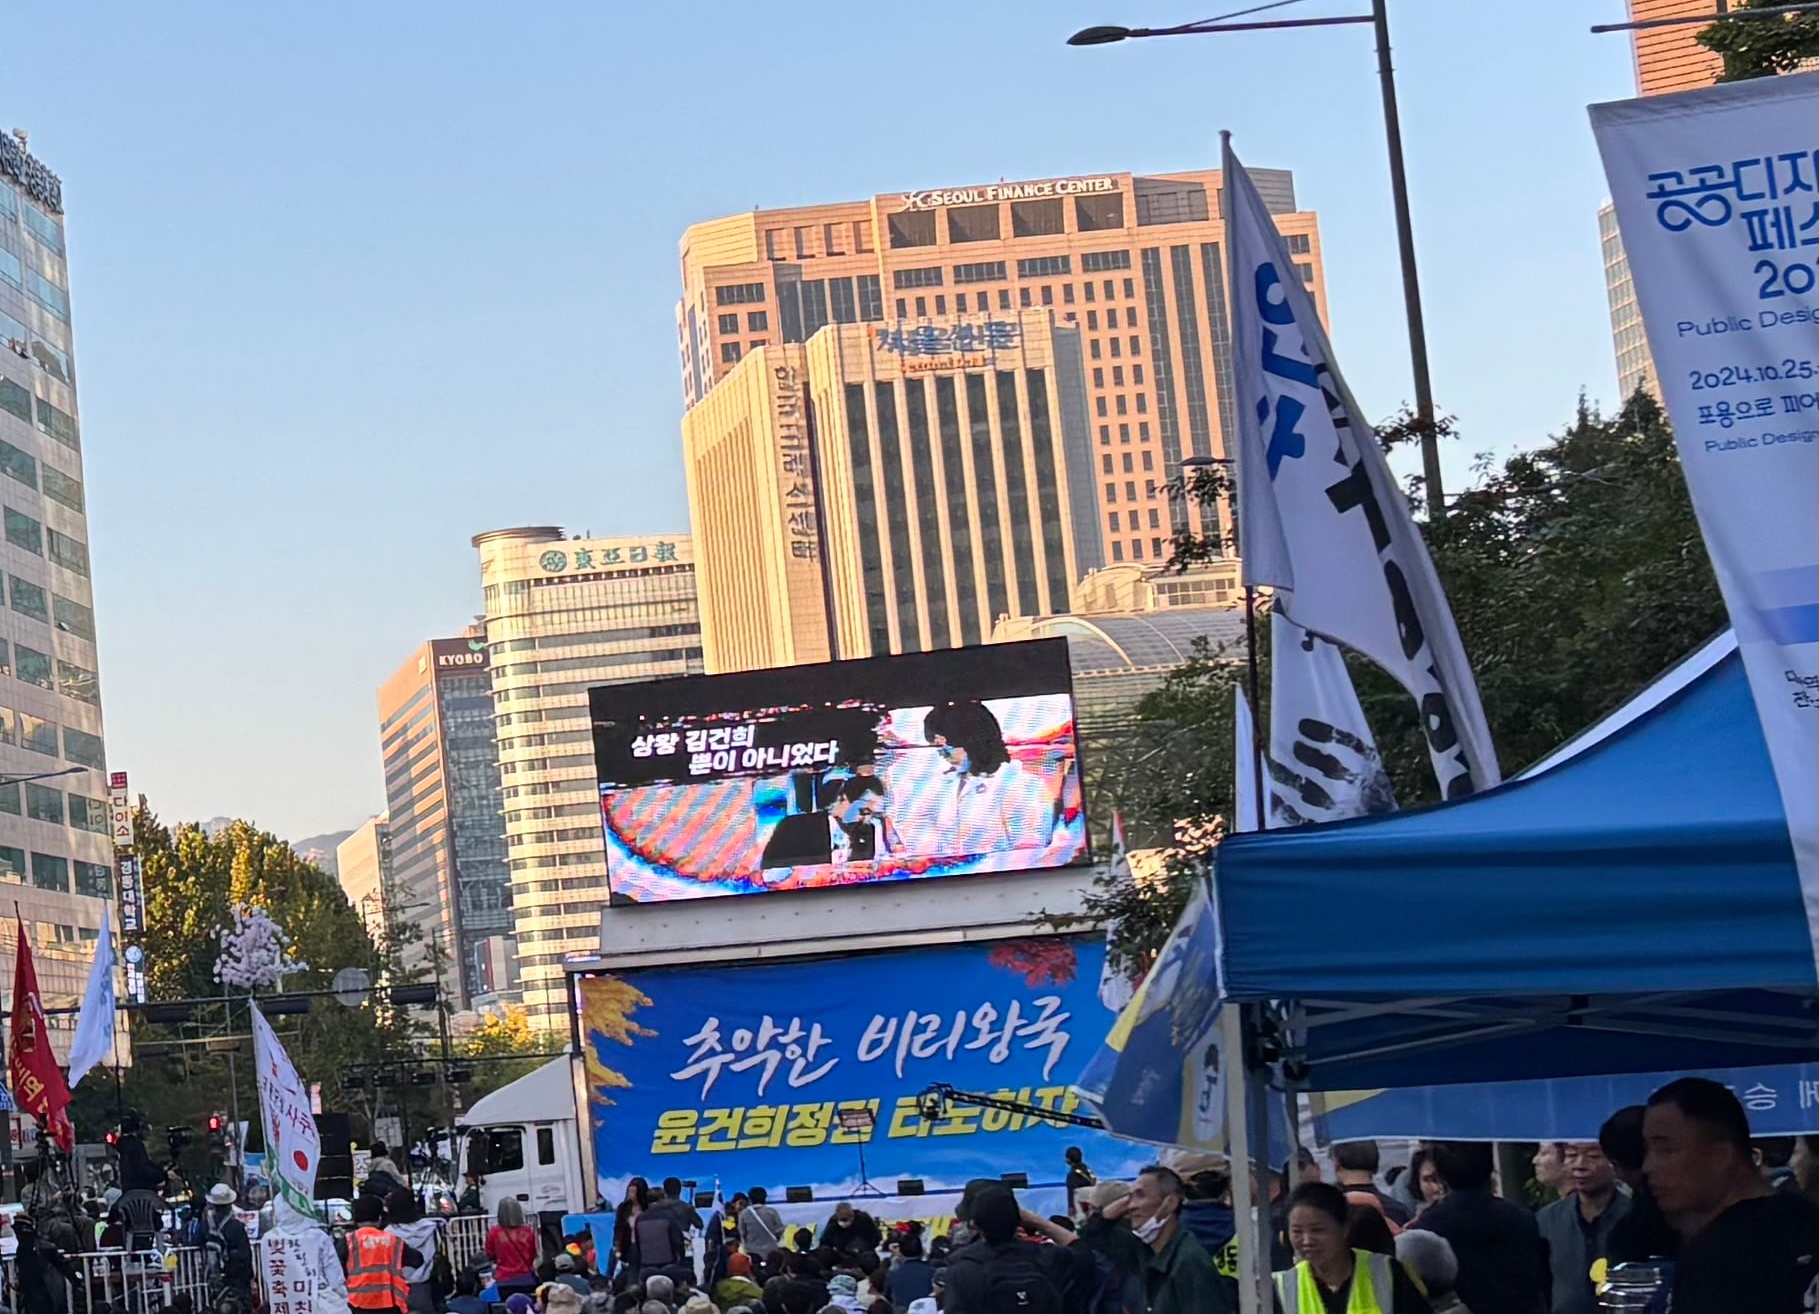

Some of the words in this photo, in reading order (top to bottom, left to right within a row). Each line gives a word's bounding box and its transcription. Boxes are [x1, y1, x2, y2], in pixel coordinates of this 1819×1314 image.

[931, 189, 984, 206] SEOUL
[986, 182, 1054, 201] FINANCE
[1055, 177, 1113, 194] CENTER
[1677, 316, 1752, 337] Public
[1698, 397, 1775, 428] 포용으로
[1705, 437, 1759, 452] Public
[439, 652, 484, 666] KYOBO
[631, 733, 680, 757] 상왕
[685, 725, 755, 753] 김건희
[742, 740, 839, 769] 아니었다
[113, 795, 129, 836] 다이소
[670, 1015, 839, 1100] 추악한
[857, 996, 1071, 1081] 비리왕국
